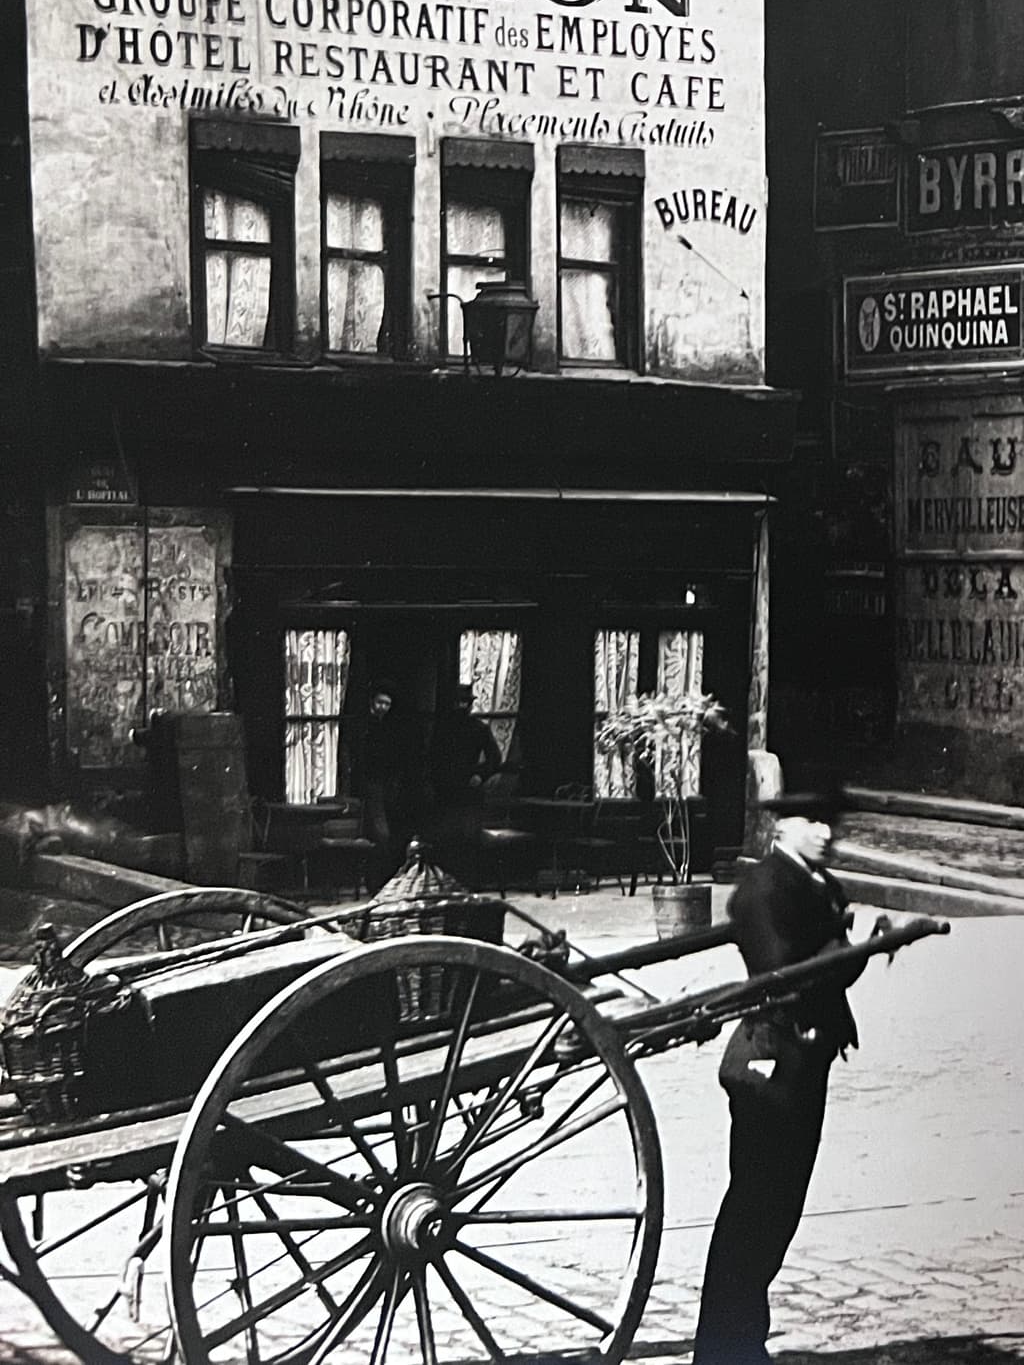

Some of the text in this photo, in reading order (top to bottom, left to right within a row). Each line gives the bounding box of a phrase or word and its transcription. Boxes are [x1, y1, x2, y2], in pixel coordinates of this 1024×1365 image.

[495, 16, 529, 47] des
[273, 39, 535, 96] RESTAURANT
[557, 65, 605, 101] ET
[654, 189, 757, 235] BUREAU
[910, 284, 1018, 321] RAPHAEL
[889, 318, 1009, 353] QUINQUINA
